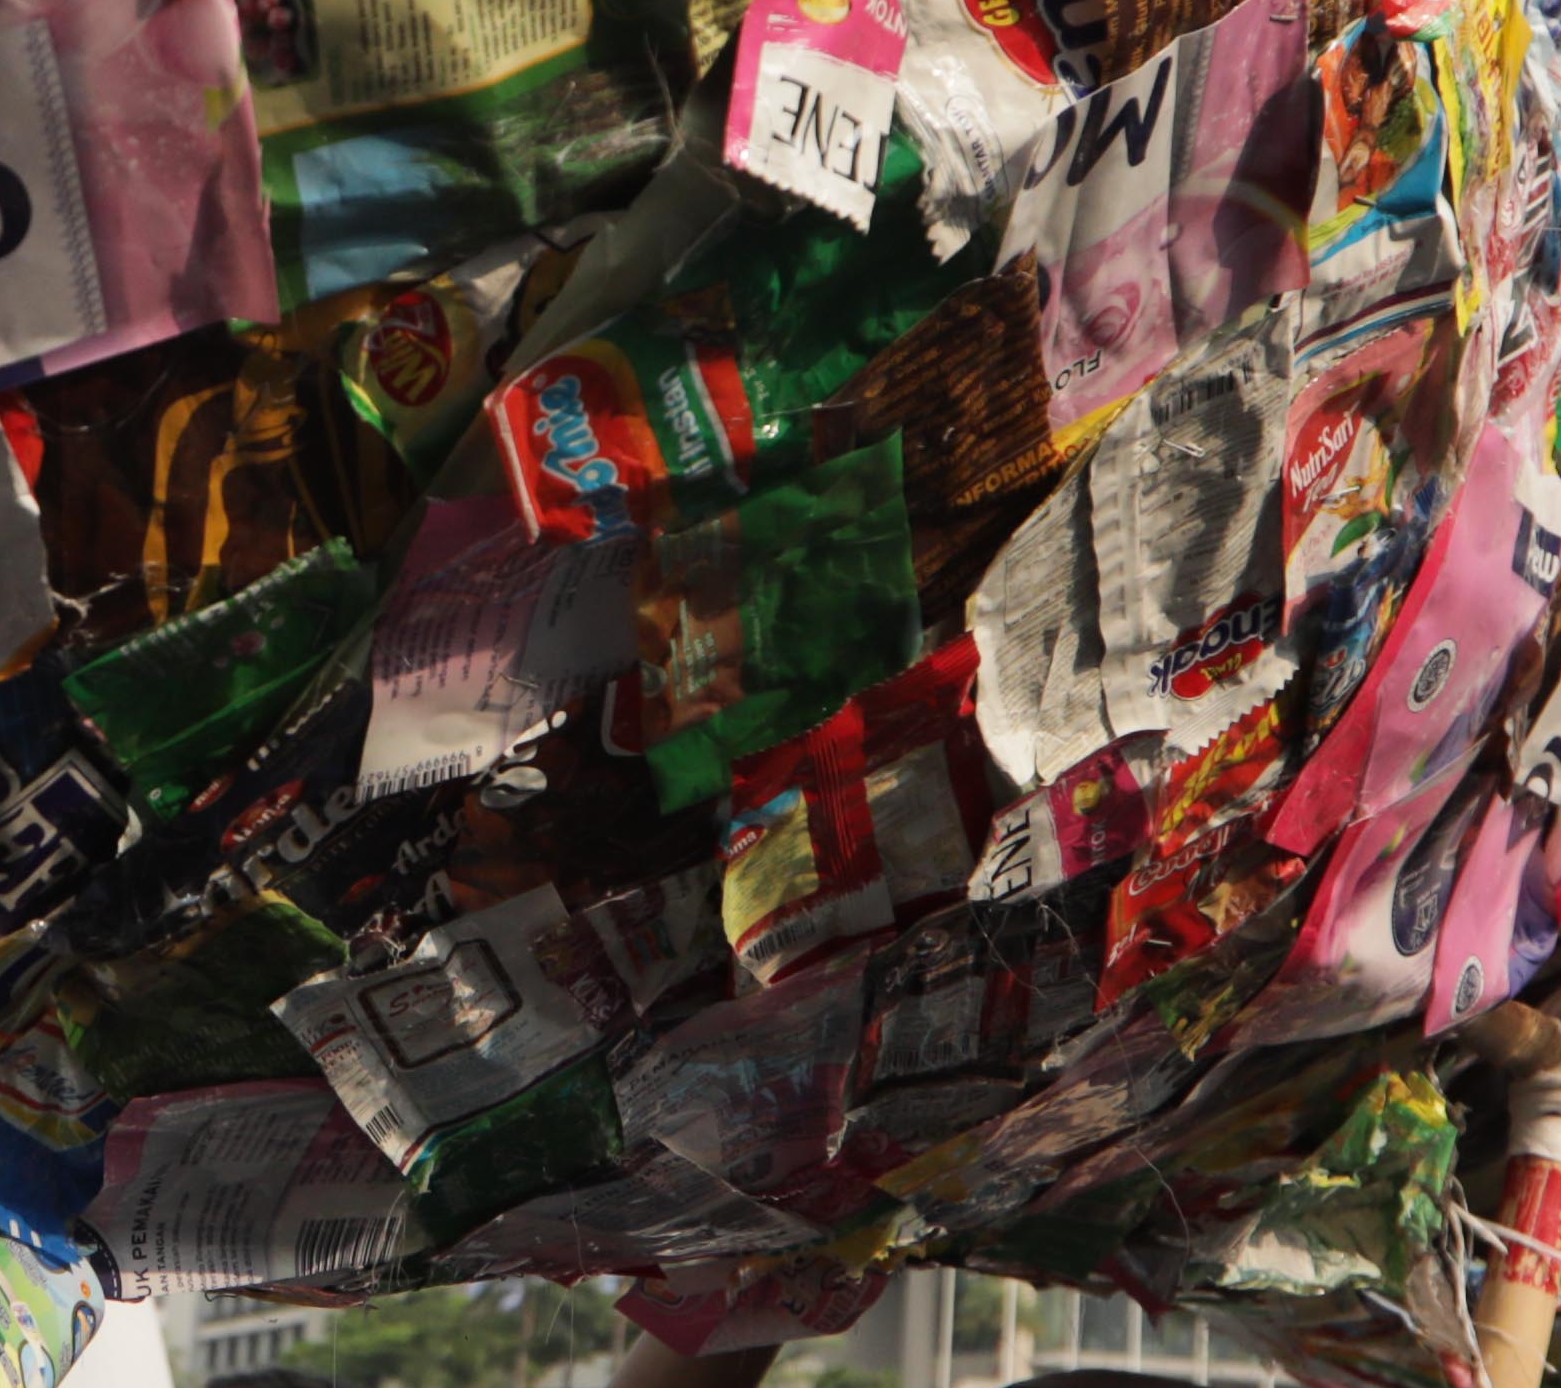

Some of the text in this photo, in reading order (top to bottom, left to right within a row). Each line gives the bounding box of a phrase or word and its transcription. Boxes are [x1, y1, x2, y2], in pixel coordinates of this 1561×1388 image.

[774, 75, 864, 183] ENE
[1053, 352, 1103, 396] FLO
[535, 373, 642, 549] Indomie
[655, 385, 709, 484] Instan
[1287, 405, 1356, 495] NutriSari
